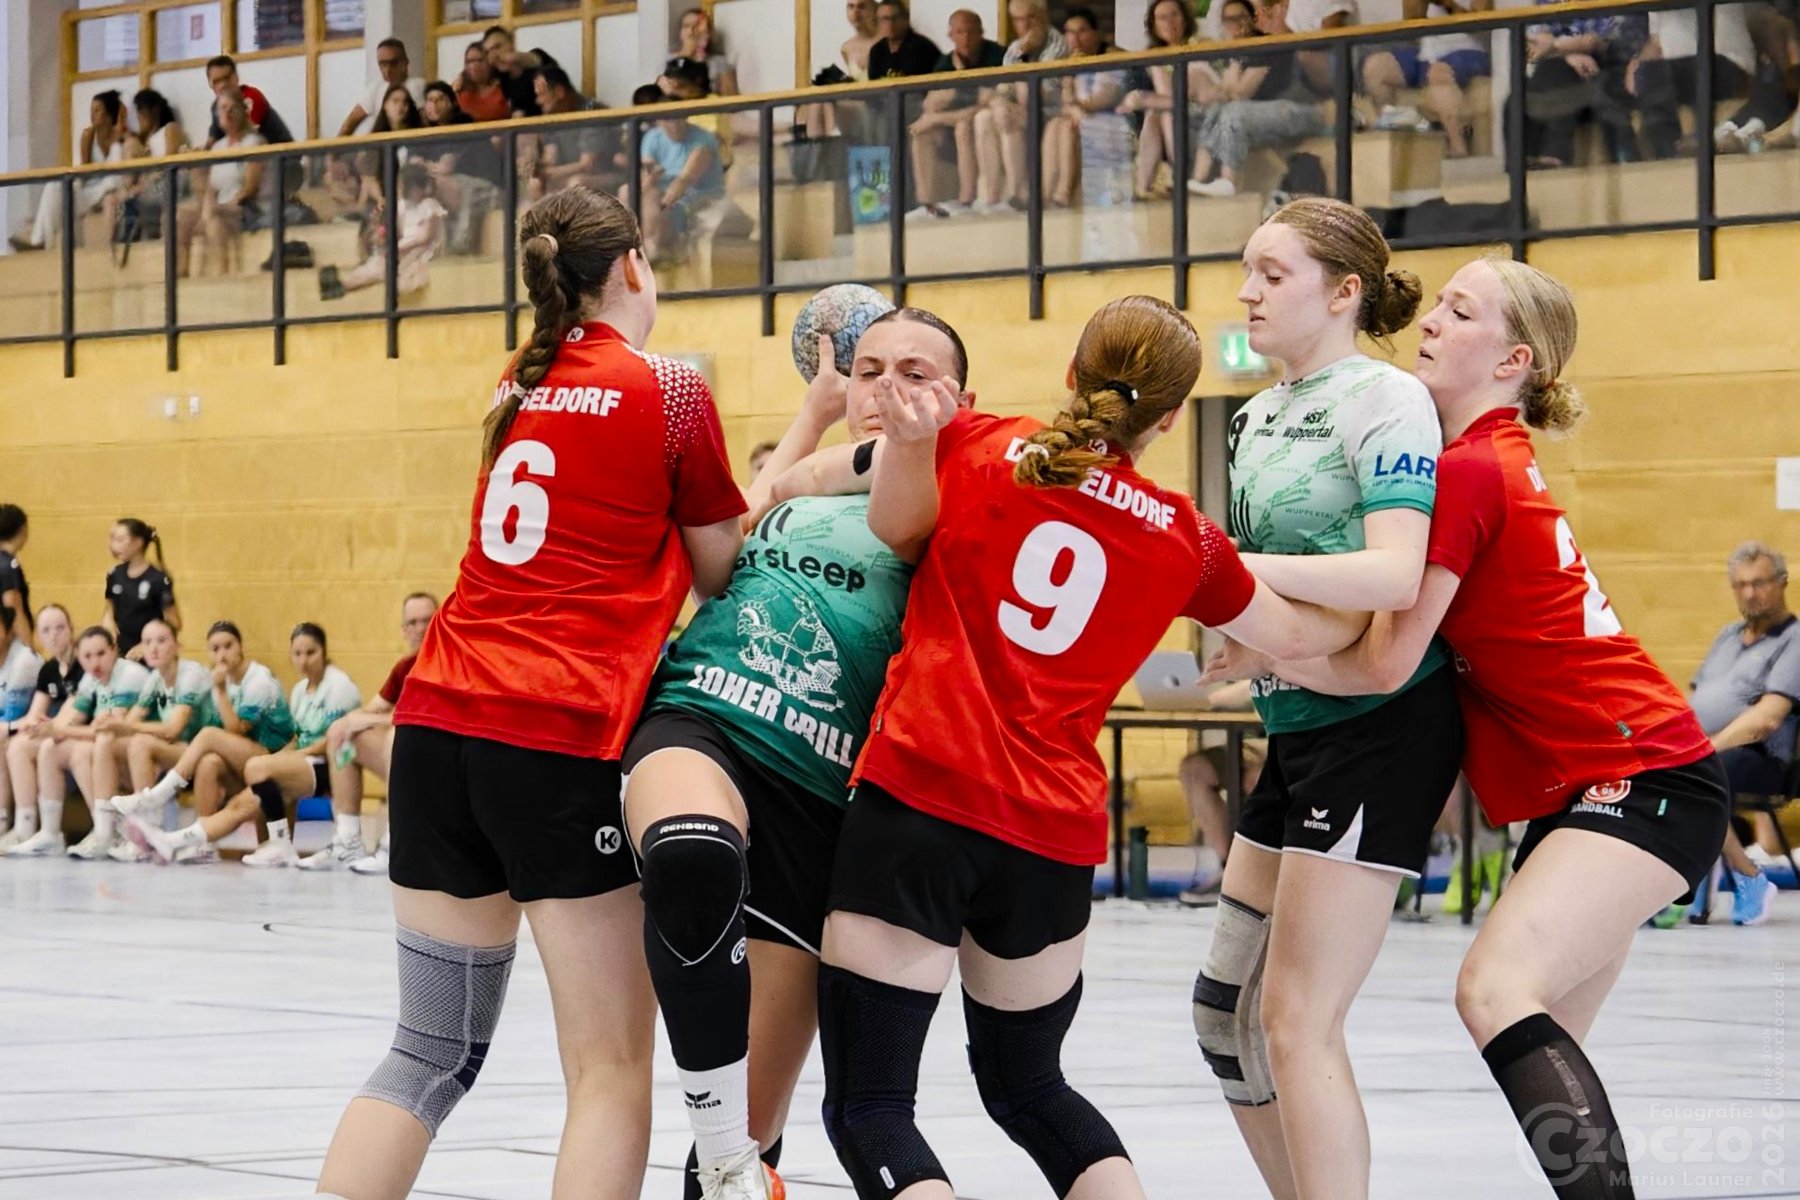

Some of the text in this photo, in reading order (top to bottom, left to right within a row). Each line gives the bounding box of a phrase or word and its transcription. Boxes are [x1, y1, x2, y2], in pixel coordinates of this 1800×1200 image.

[1282, 425, 1335, 443] Wuppertal
[480, 440, 556, 565] 6
[998, 520, 1107, 655] 9
[1303, 819, 1331, 832] erima
